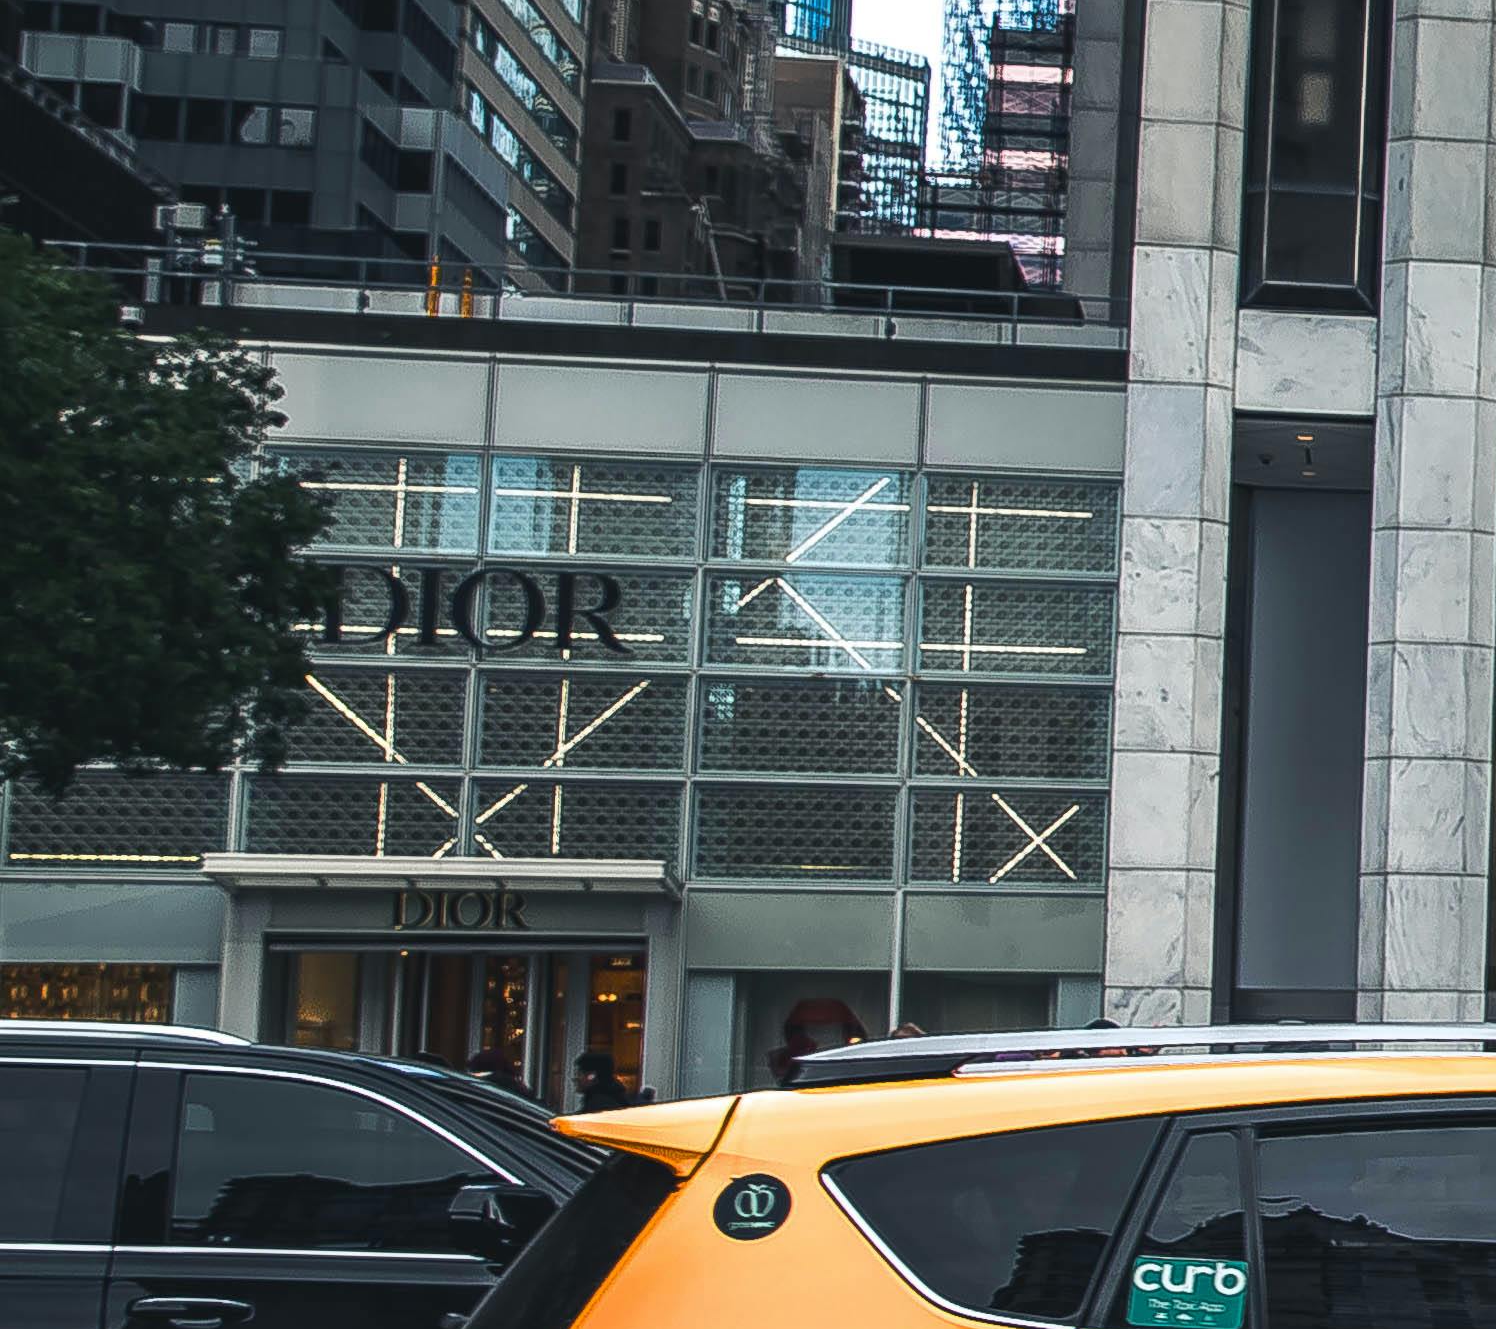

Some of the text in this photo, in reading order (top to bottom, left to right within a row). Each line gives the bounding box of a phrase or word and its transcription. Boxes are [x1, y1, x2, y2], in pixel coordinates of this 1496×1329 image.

[323, 563, 633, 653] DIOR
[393, 890, 531, 930] DIOR
[1133, 1262, 1247, 1296] curb
